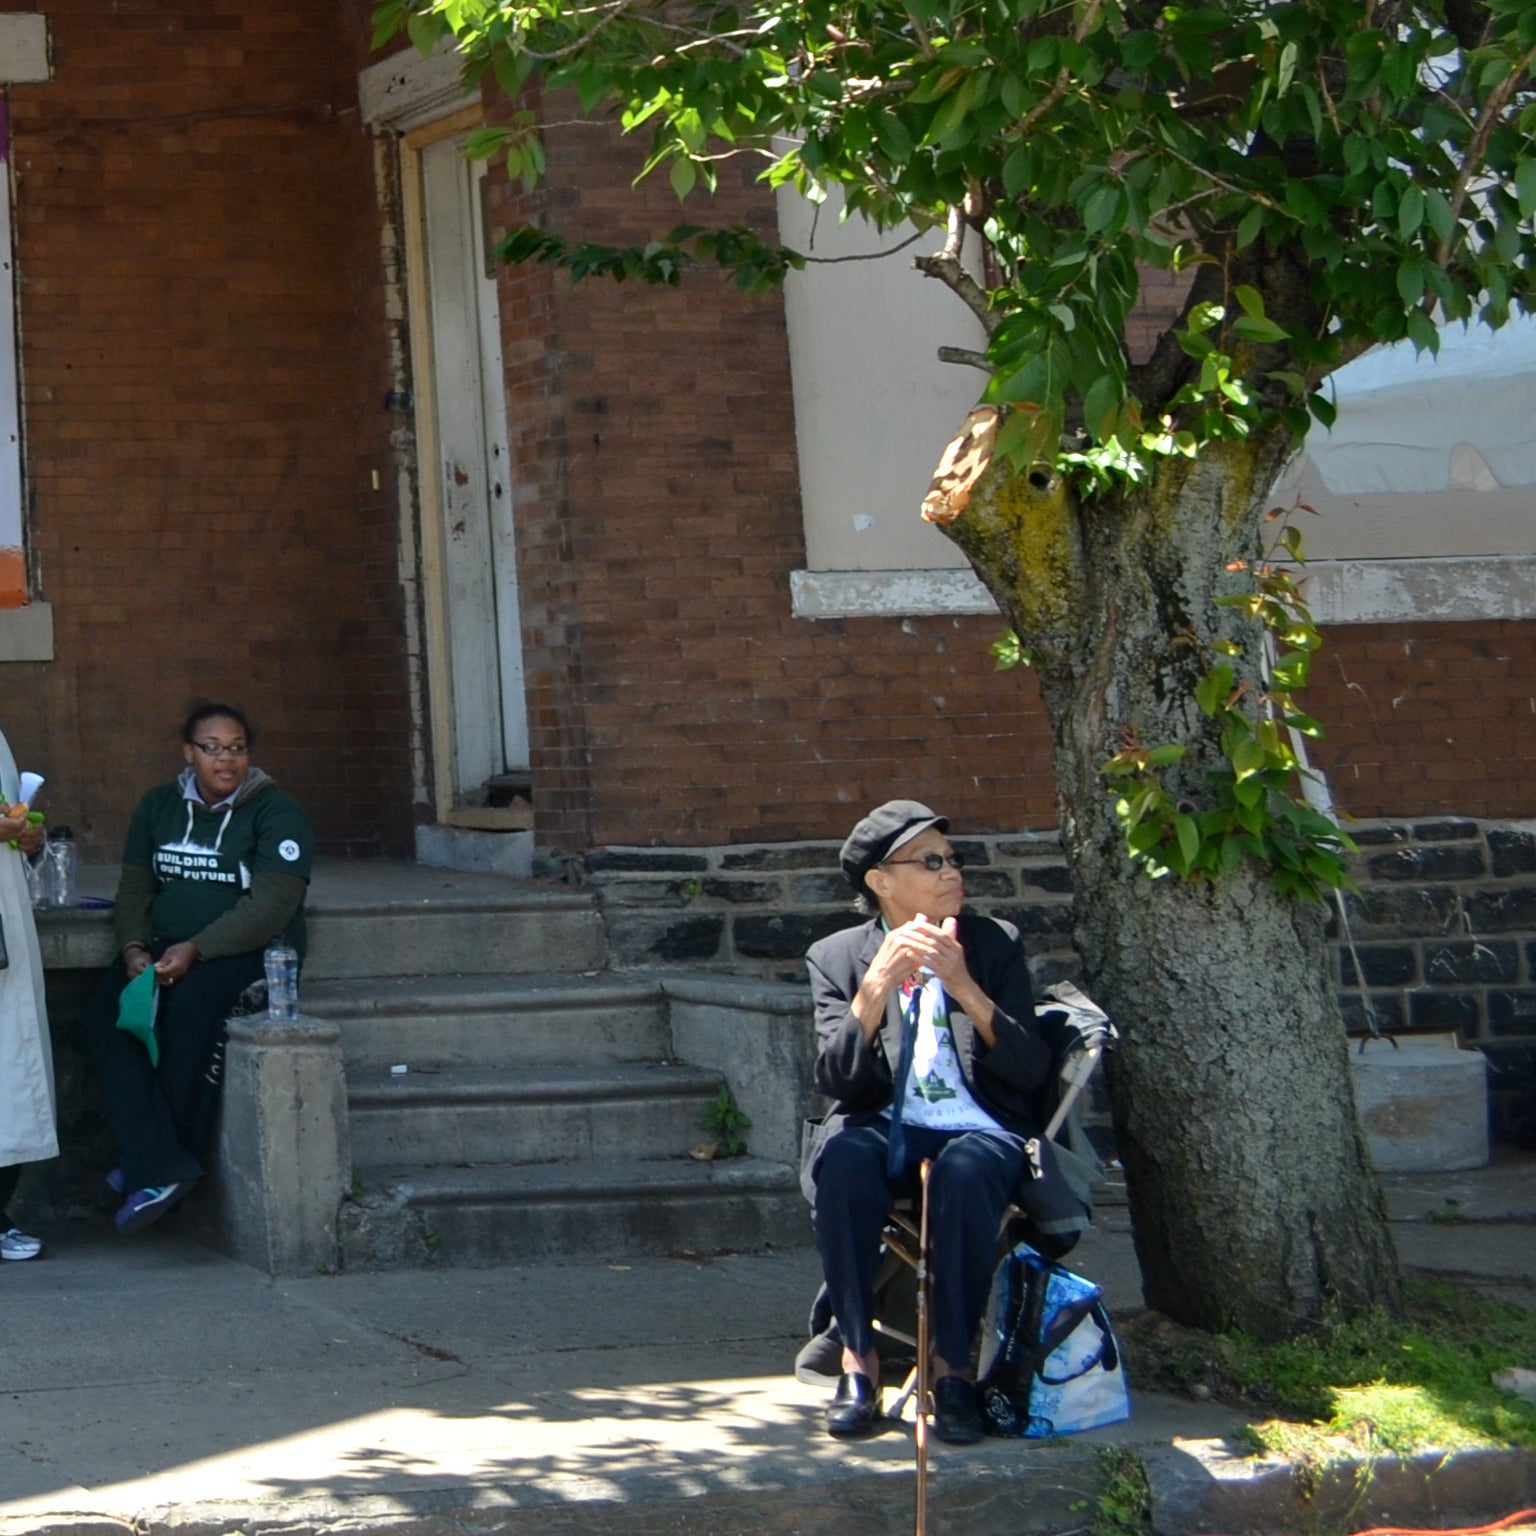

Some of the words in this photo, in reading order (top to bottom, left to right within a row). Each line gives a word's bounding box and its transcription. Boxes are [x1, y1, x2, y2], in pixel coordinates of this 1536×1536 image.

[157, 852, 219, 868] BUILDING
[160, 864, 182, 874] OUR
[183, 870, 237, 882] FUTURE
